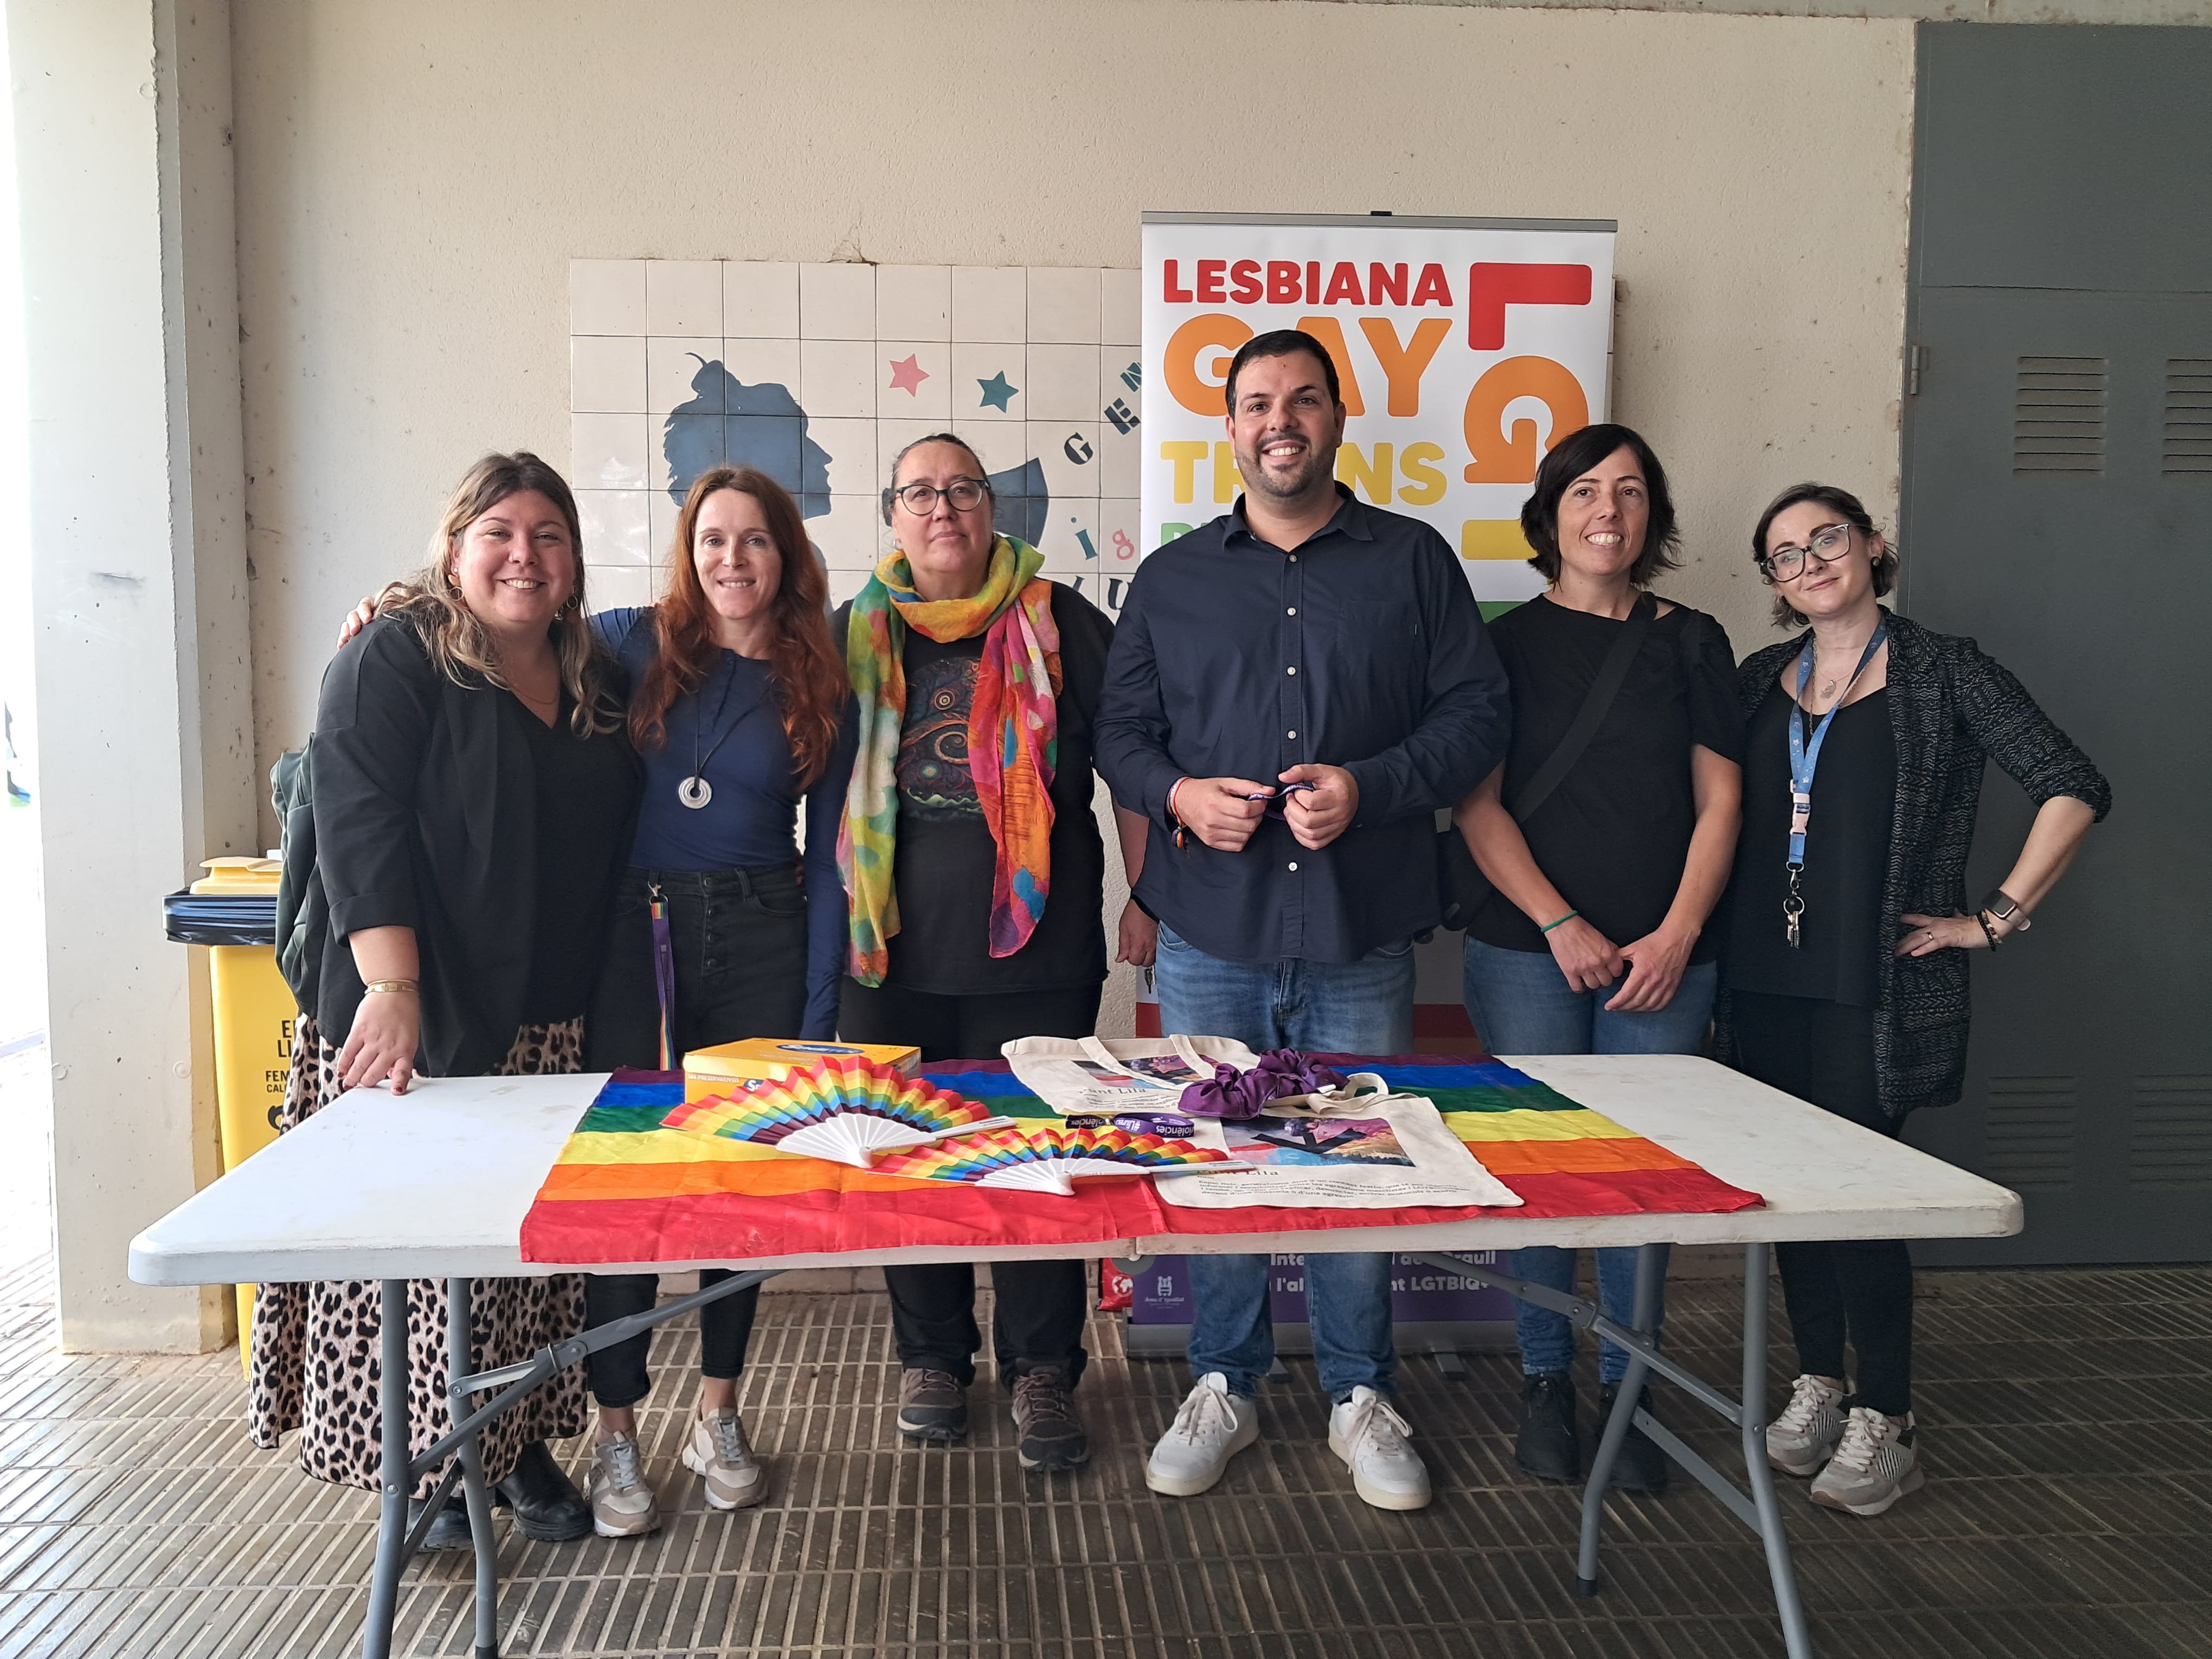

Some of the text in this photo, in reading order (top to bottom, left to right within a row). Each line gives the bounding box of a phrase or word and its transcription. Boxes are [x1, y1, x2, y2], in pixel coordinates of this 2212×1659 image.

[1163, 259, 1454, 306] LESBIANA
[1160, 440, 1449, 506] TRNS
[267, 1084, 286, 1093] CAL
